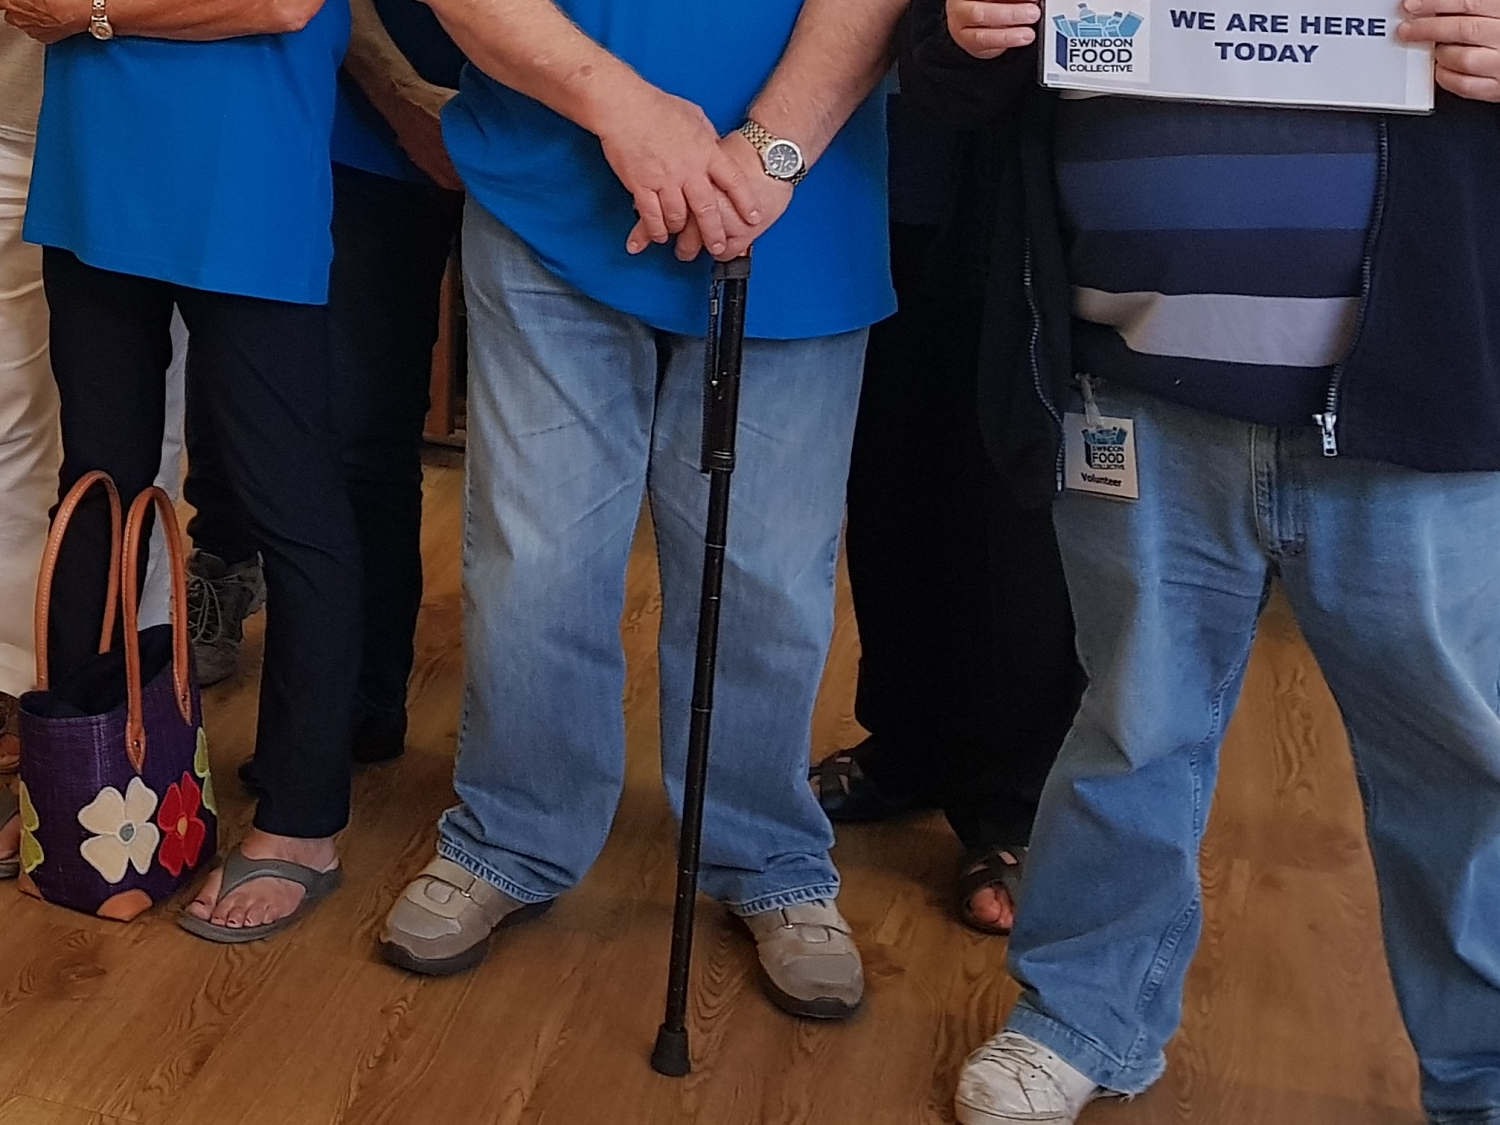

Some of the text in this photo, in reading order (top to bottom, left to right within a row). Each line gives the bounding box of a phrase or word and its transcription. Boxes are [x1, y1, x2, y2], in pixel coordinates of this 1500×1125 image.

[1169, 9, 1387, 37] WE ARE HERE
[1069, 38, 1133, 48] SWINDON
[1069, 48, 1133, 64] FOOD
[1214, 41, 1319, 63] TODAY
[1069, 64, 1133, 73] COLLECTIVE
[1092, 452, 1125, 463] FOOD
[1080, 472, 1123, 487] Volunteer
